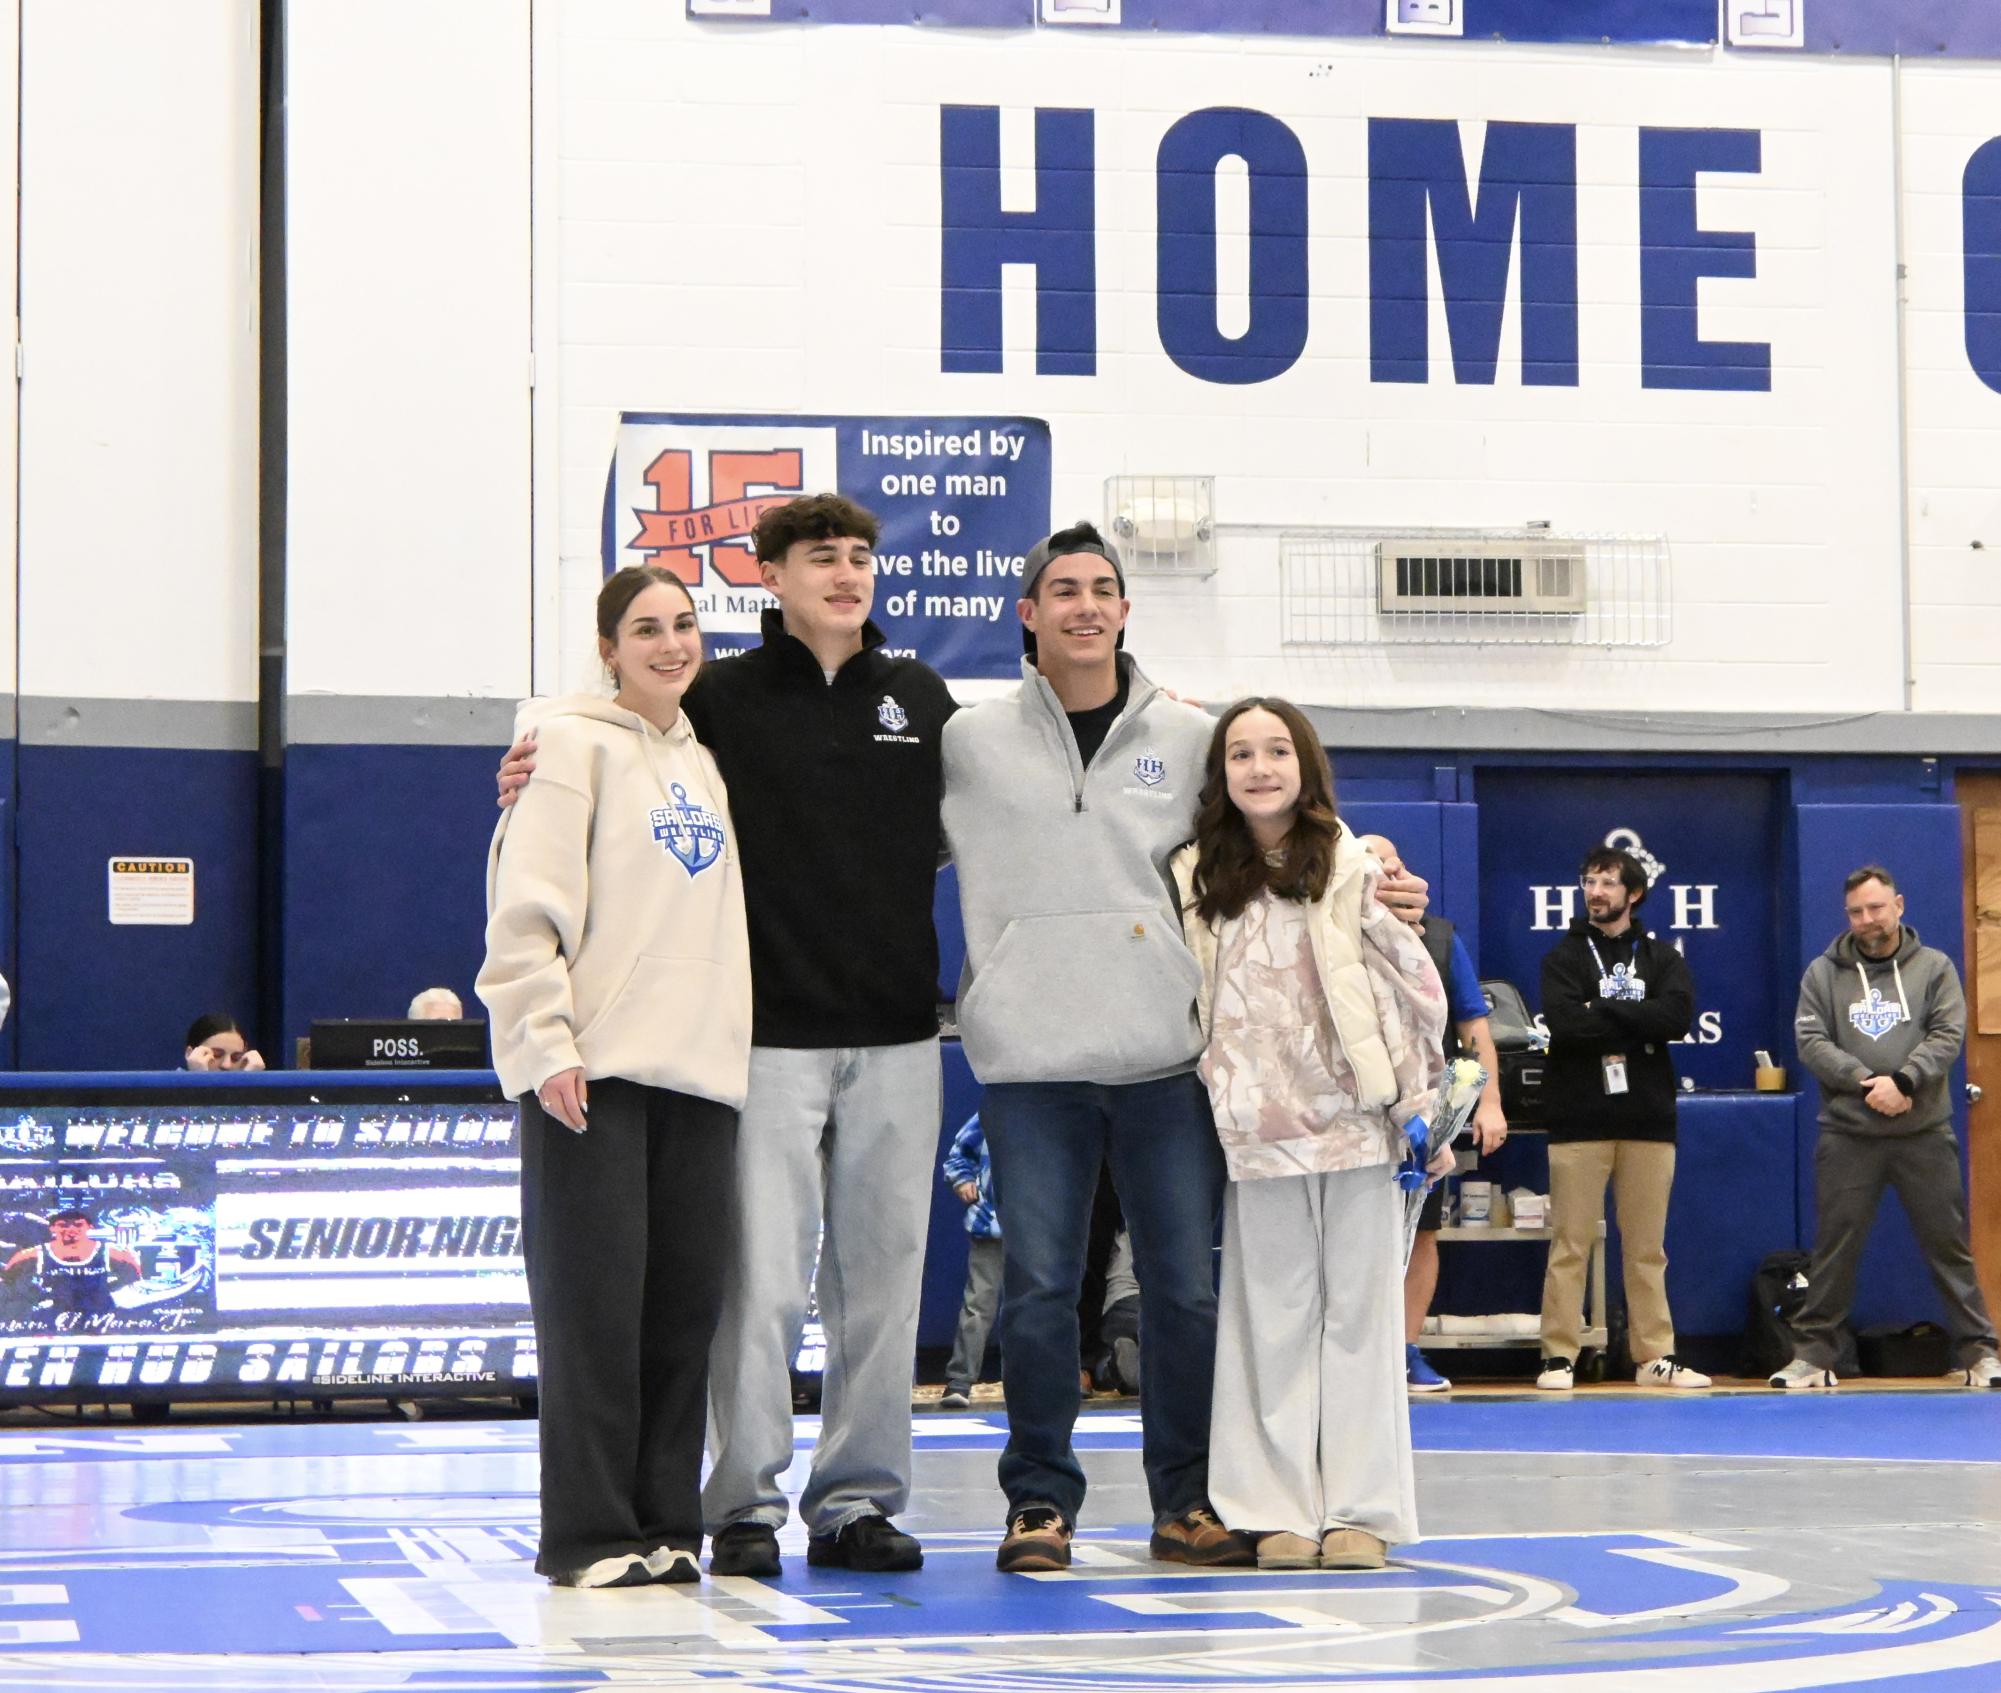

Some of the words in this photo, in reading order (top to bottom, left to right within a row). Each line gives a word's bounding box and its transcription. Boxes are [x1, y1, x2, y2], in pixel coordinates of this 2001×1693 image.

[940, 104, 1772, 392] HOME
[862, 430, 981, 460] Inspired
[990, 430, 1025, 461] by
[881, 474, 936, 496] one
[945, 474, 1006, 496] man
[668, 513, 715, 543] FOR
[930, 511, 960, 536] to
[921, 550, 968, 577] the
[976, 550, 1024, 577] live
[886, 590, 917, 617] of
[925, 595, 1004, 622] many
[658, 824, 724, 842] WRSTLING
[117, 862, 186, 873] CAUTION
[1529, 886, 1579, 930] H
[1669, 885, 1719, 929] H
[373, 1038, 424, 1057] POSS.
[63, 1115, 279, 1150] WELCOME
[240, 1216, 428, 1260] SENIOR
[428, 1216, 523, 1258] NIG
[0, 1345, 80, 1386] EN
[239, 1340, 487, 1381] SAILORS
[320, 1374, 393, 1385] SIDELINE
[398, 1371, 496, 1383] INTERACTIVE
